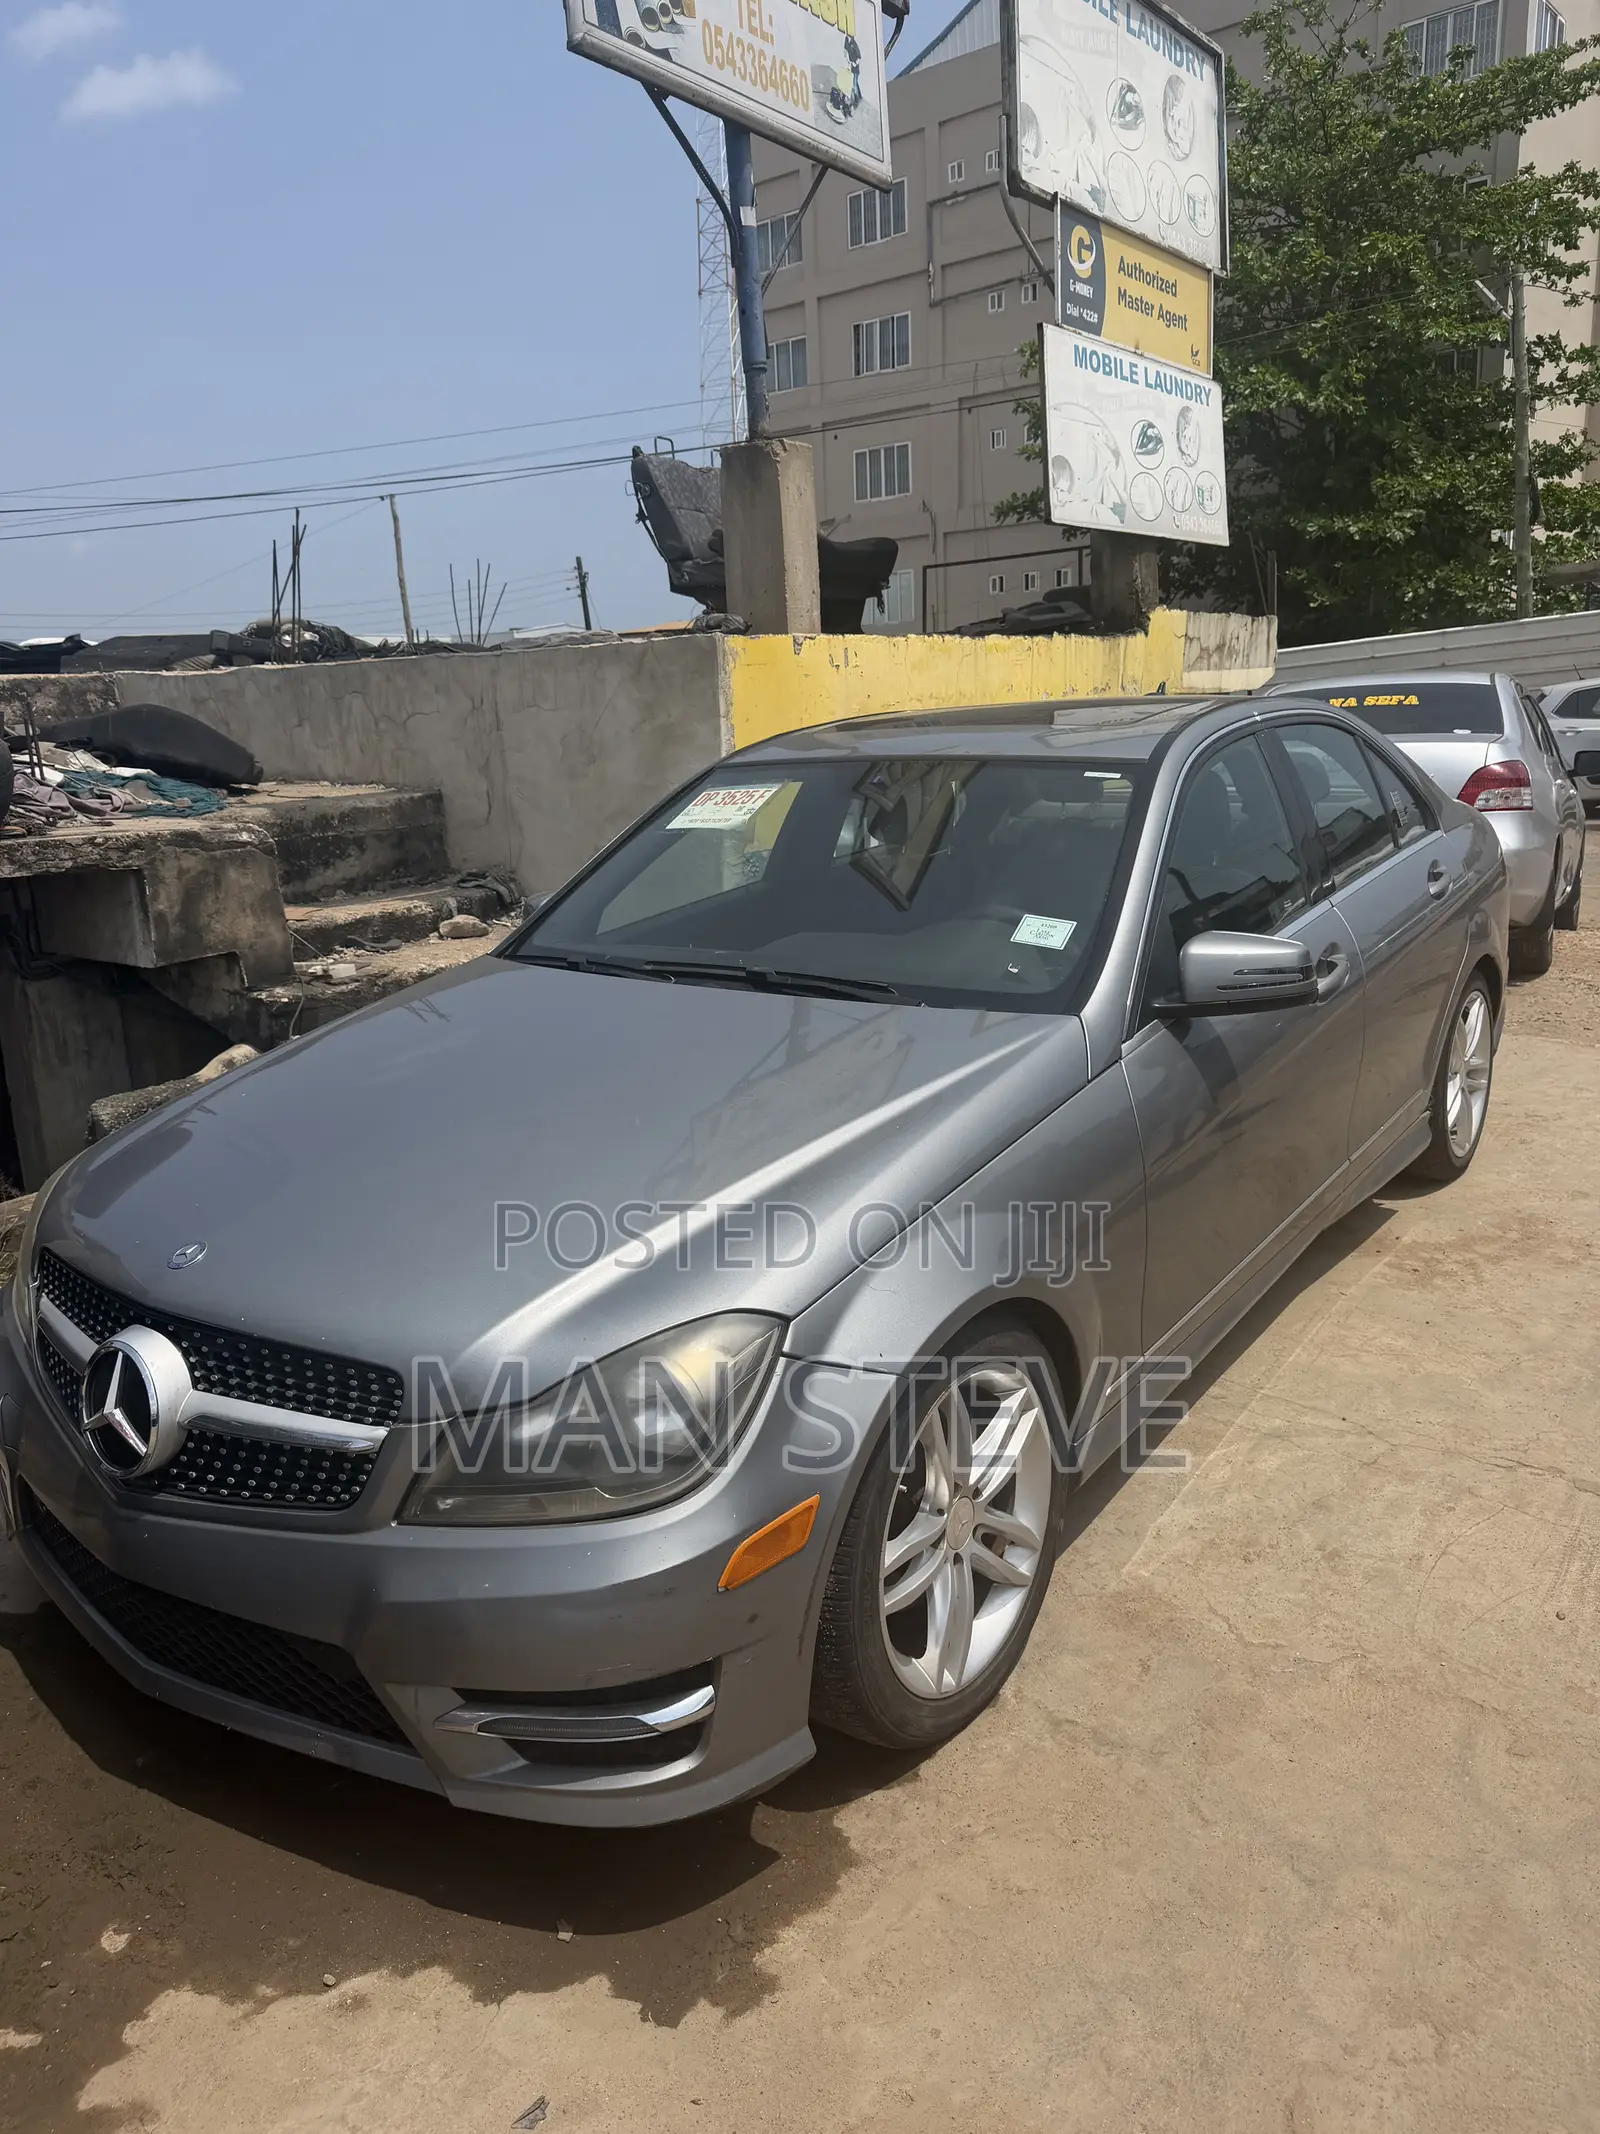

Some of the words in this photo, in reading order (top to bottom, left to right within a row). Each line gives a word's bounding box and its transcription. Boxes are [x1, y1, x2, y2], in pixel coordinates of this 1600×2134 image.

[1126, 2, 1206, 82] LAUNDRY
[702, 18, 810, 112] 0543364660
[1069, 279, 1094, 299] G-MONEY
[1117, 255, 1177, 298] Authorized
[1066, 302, 1080, 316] Dial
[1117, 286, 1155, 318] Master
[1157, 303, 1188, 332] Agent
[1073, 344, 1140, 386] MOBILE
[1144, 366, 1212, 408] LAUNDRY
[1363, 695, 1420, 706] SEFA
[691, 791, 720, 807] DP
[713, 789, 760, 806] 3525
[751, 789, 773, 804] F
